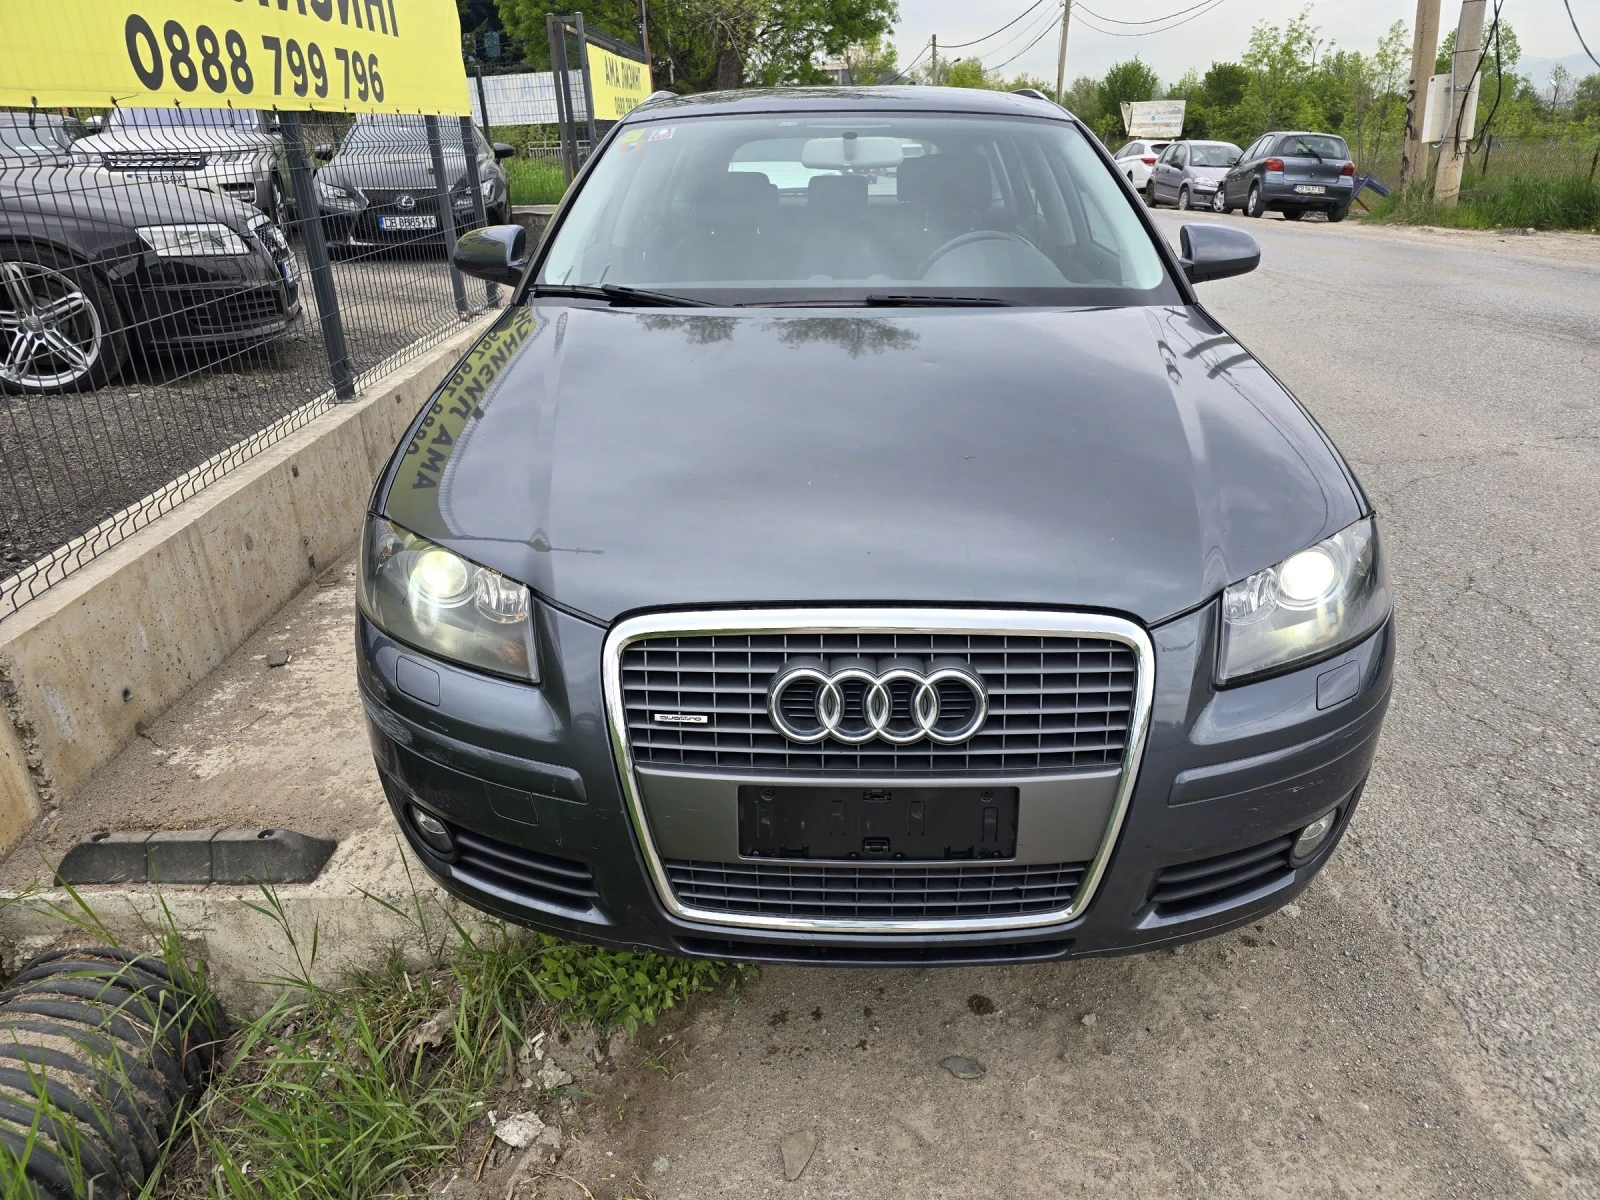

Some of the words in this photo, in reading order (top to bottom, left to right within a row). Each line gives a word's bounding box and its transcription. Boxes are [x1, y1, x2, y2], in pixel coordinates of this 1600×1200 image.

[125, 14, 254, 94] 0888
[261, 35, 329, 98] 799
[334, 47, 385, 103] 796
